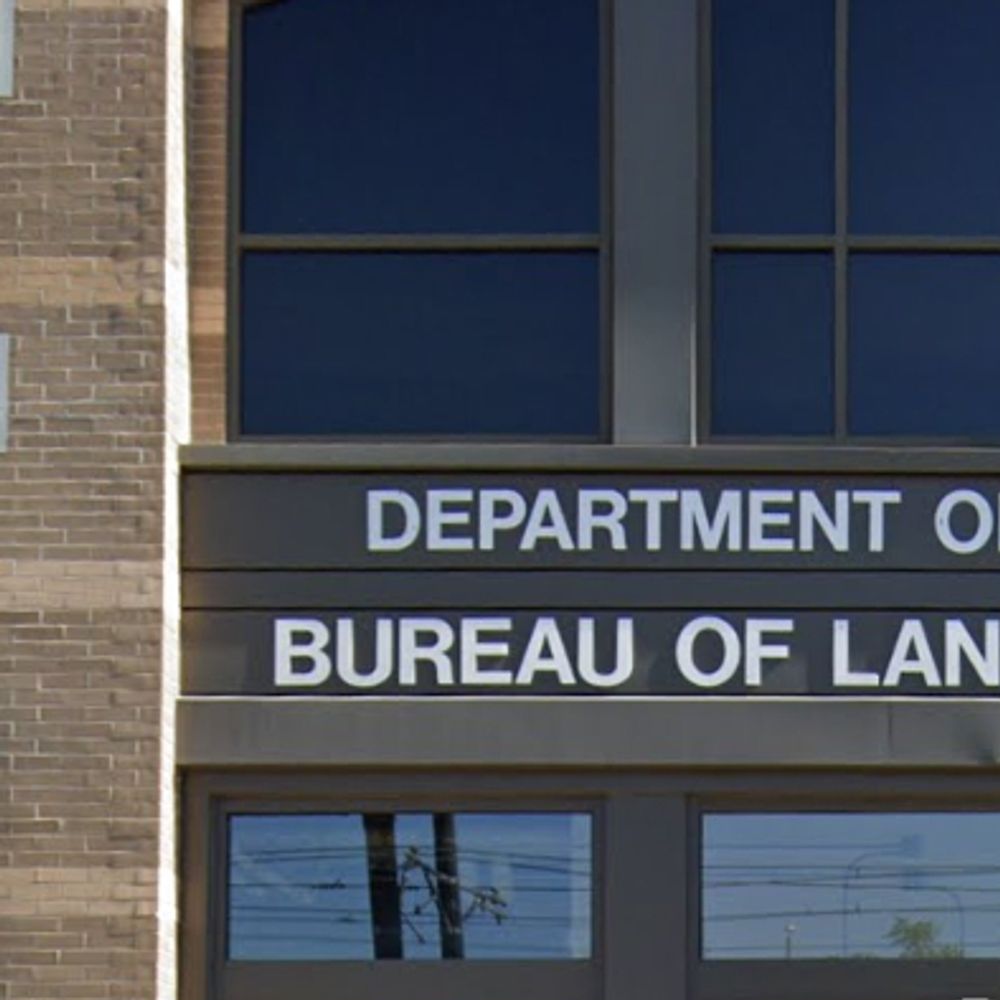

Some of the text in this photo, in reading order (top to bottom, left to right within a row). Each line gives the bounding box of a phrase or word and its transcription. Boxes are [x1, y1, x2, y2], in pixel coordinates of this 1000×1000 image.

[366, 488, 902, 554] DEPARTMENT
[273, 616, 635, 688] BUREAU
[674, 616, 795, 688] OF
